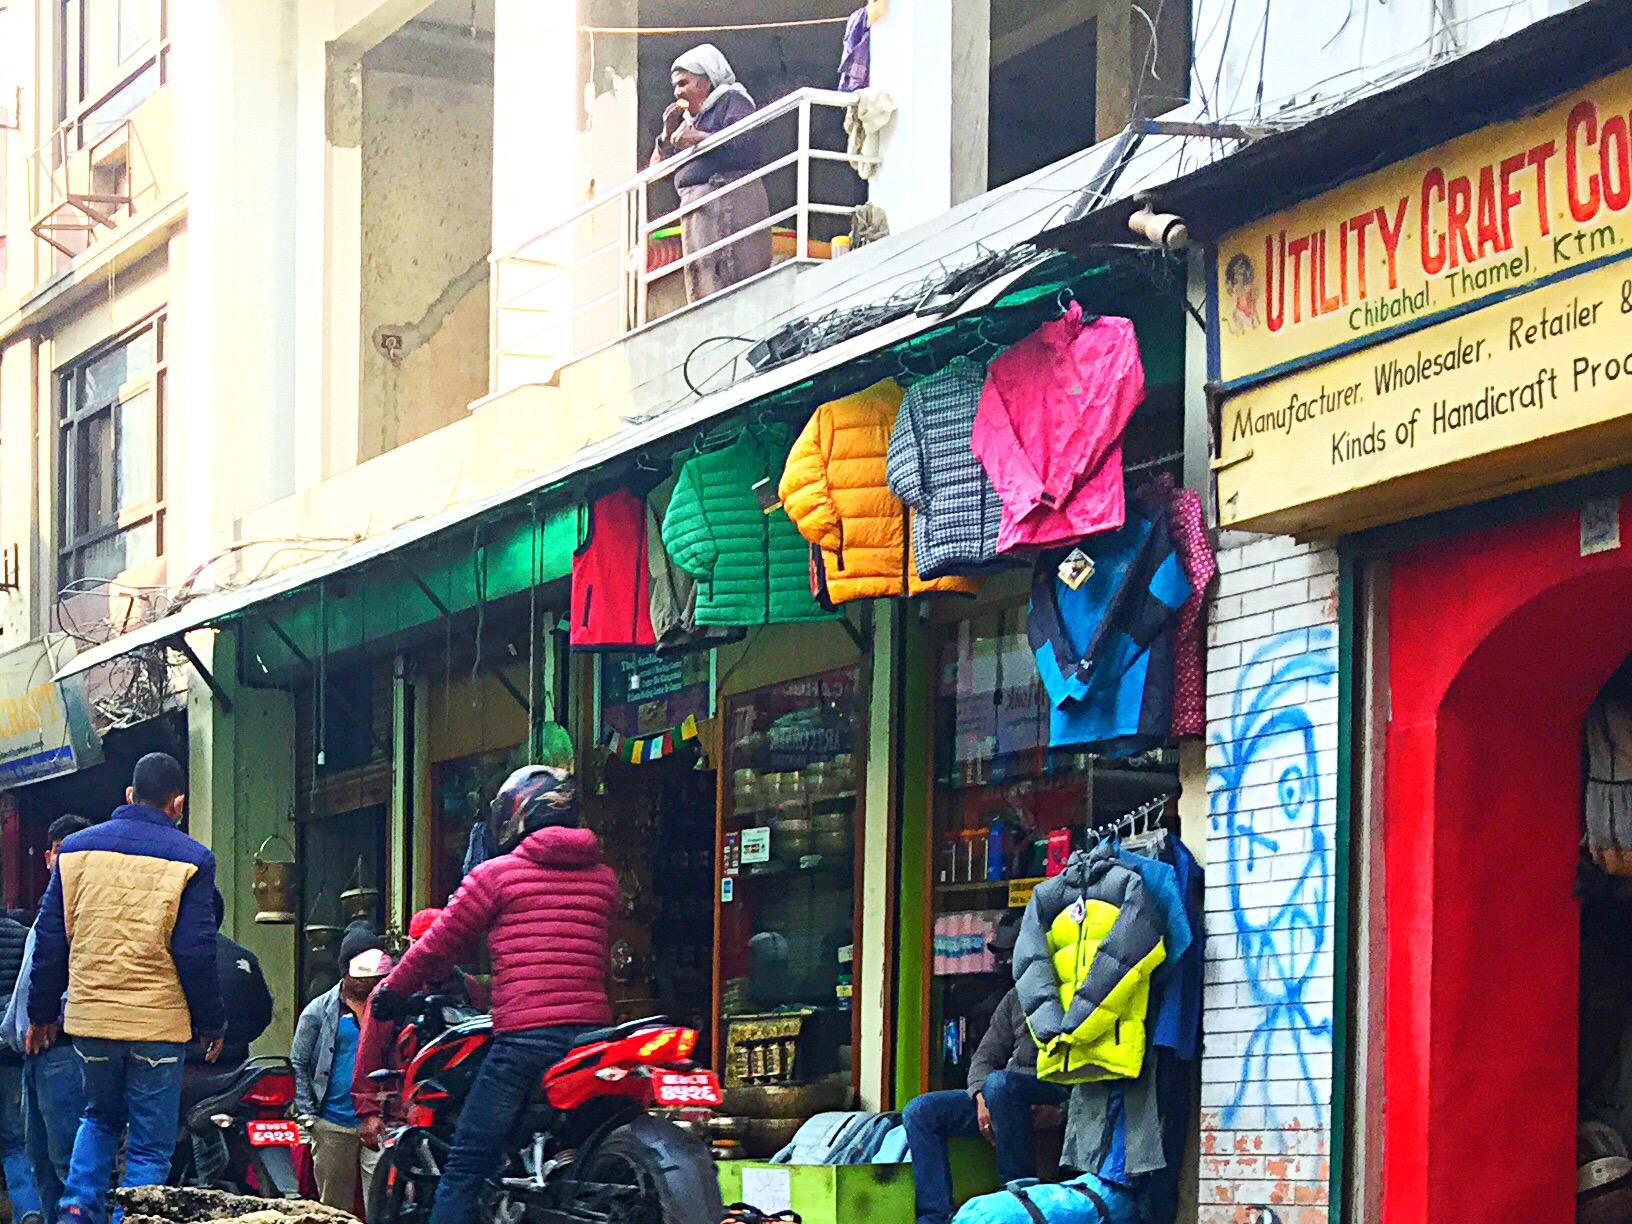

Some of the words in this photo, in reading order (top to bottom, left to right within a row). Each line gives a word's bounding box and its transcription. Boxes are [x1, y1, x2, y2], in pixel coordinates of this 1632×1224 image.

[1264, 195, 1410, 332] UTILITY
[1421, 139, 1557, 275] CRAFT
[1566, 101, 1632, 222] CO
[1445, 247, 1537, 299] Thamel,
[1374, 337, 1492, 398] Wholesaler,
[1508, 297, 1603, 352] Retailer
[1331, 421, 1386, 465] Kinds
[1395, 406, 1420, 449] of
[1432, 368, 1558, 435] Handicraft
